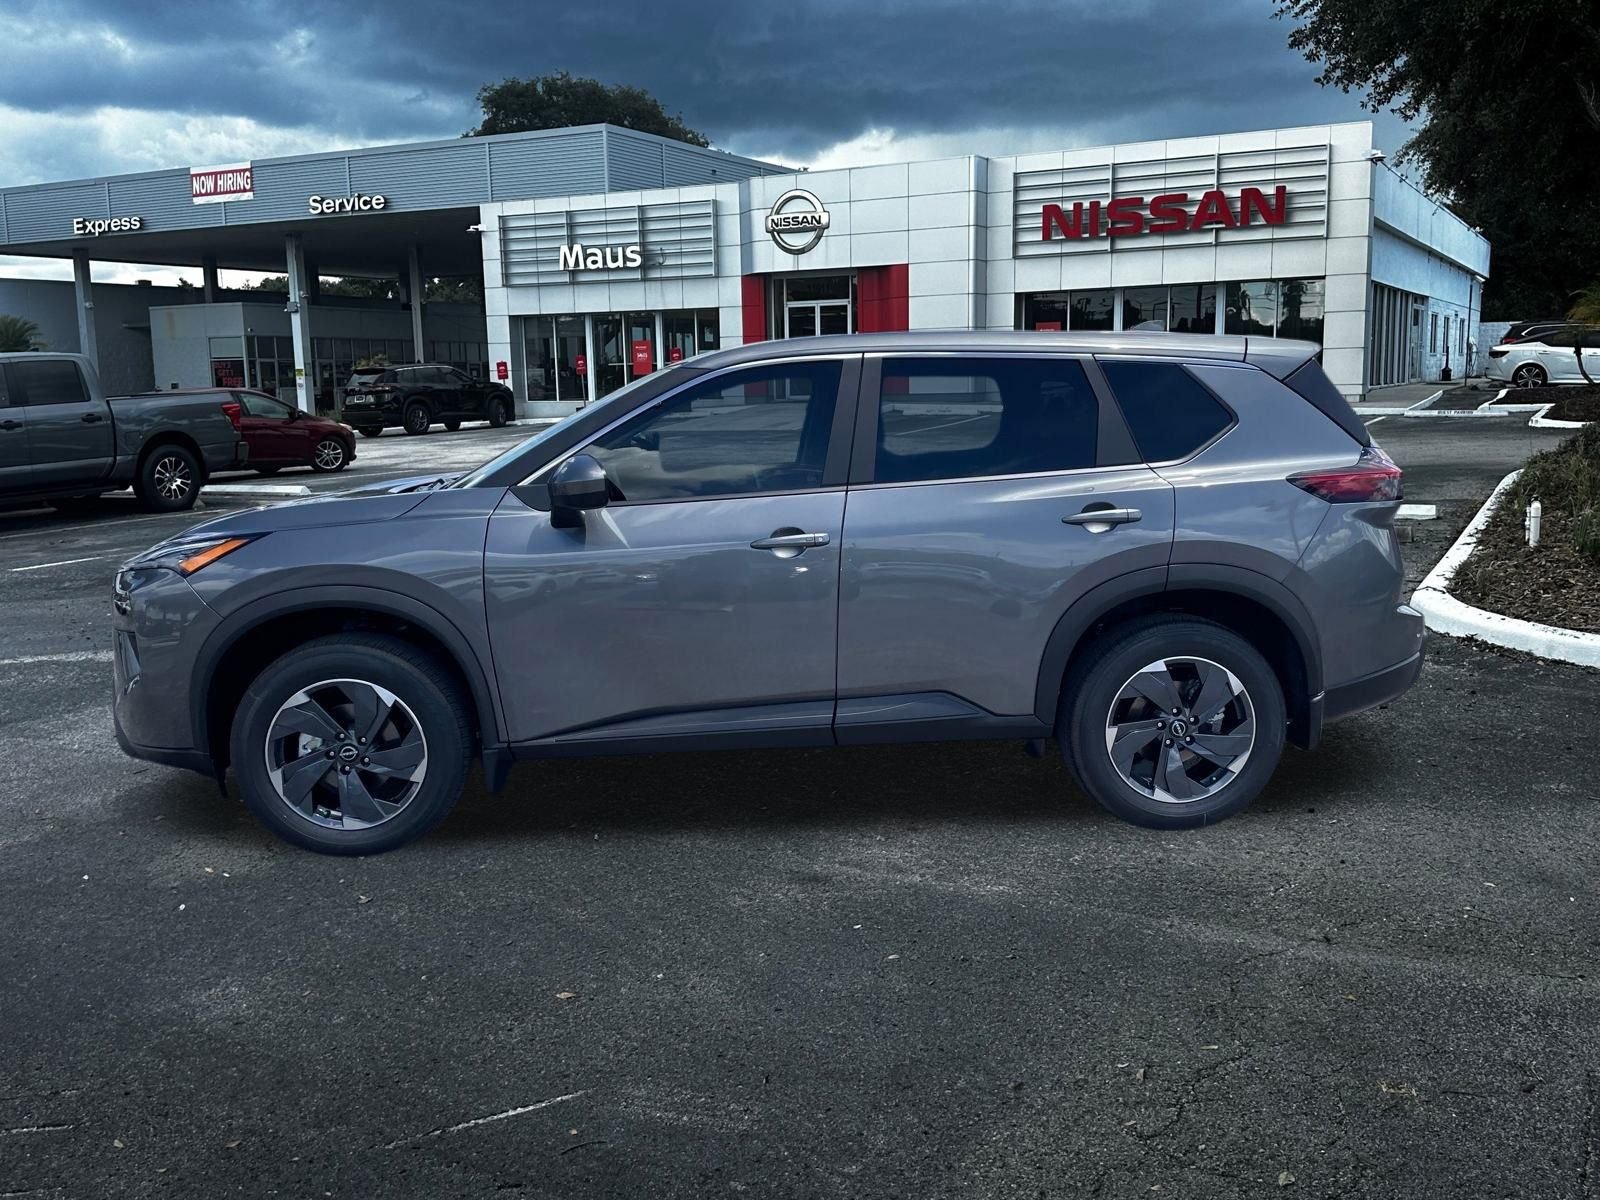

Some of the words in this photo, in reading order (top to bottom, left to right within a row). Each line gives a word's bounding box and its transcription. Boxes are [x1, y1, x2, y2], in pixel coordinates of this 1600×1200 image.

[193, 174, 215, 195] NOW
[217, 171, 251, 192] HIRING
[308, 193, 385, 214] Service
[1042, 185, 1287, 241] NISSAN
[73, 216, 141, 236] Express
[770, 215, 822, 228] NISSAN
[560, 243, 642, 271] Maus
